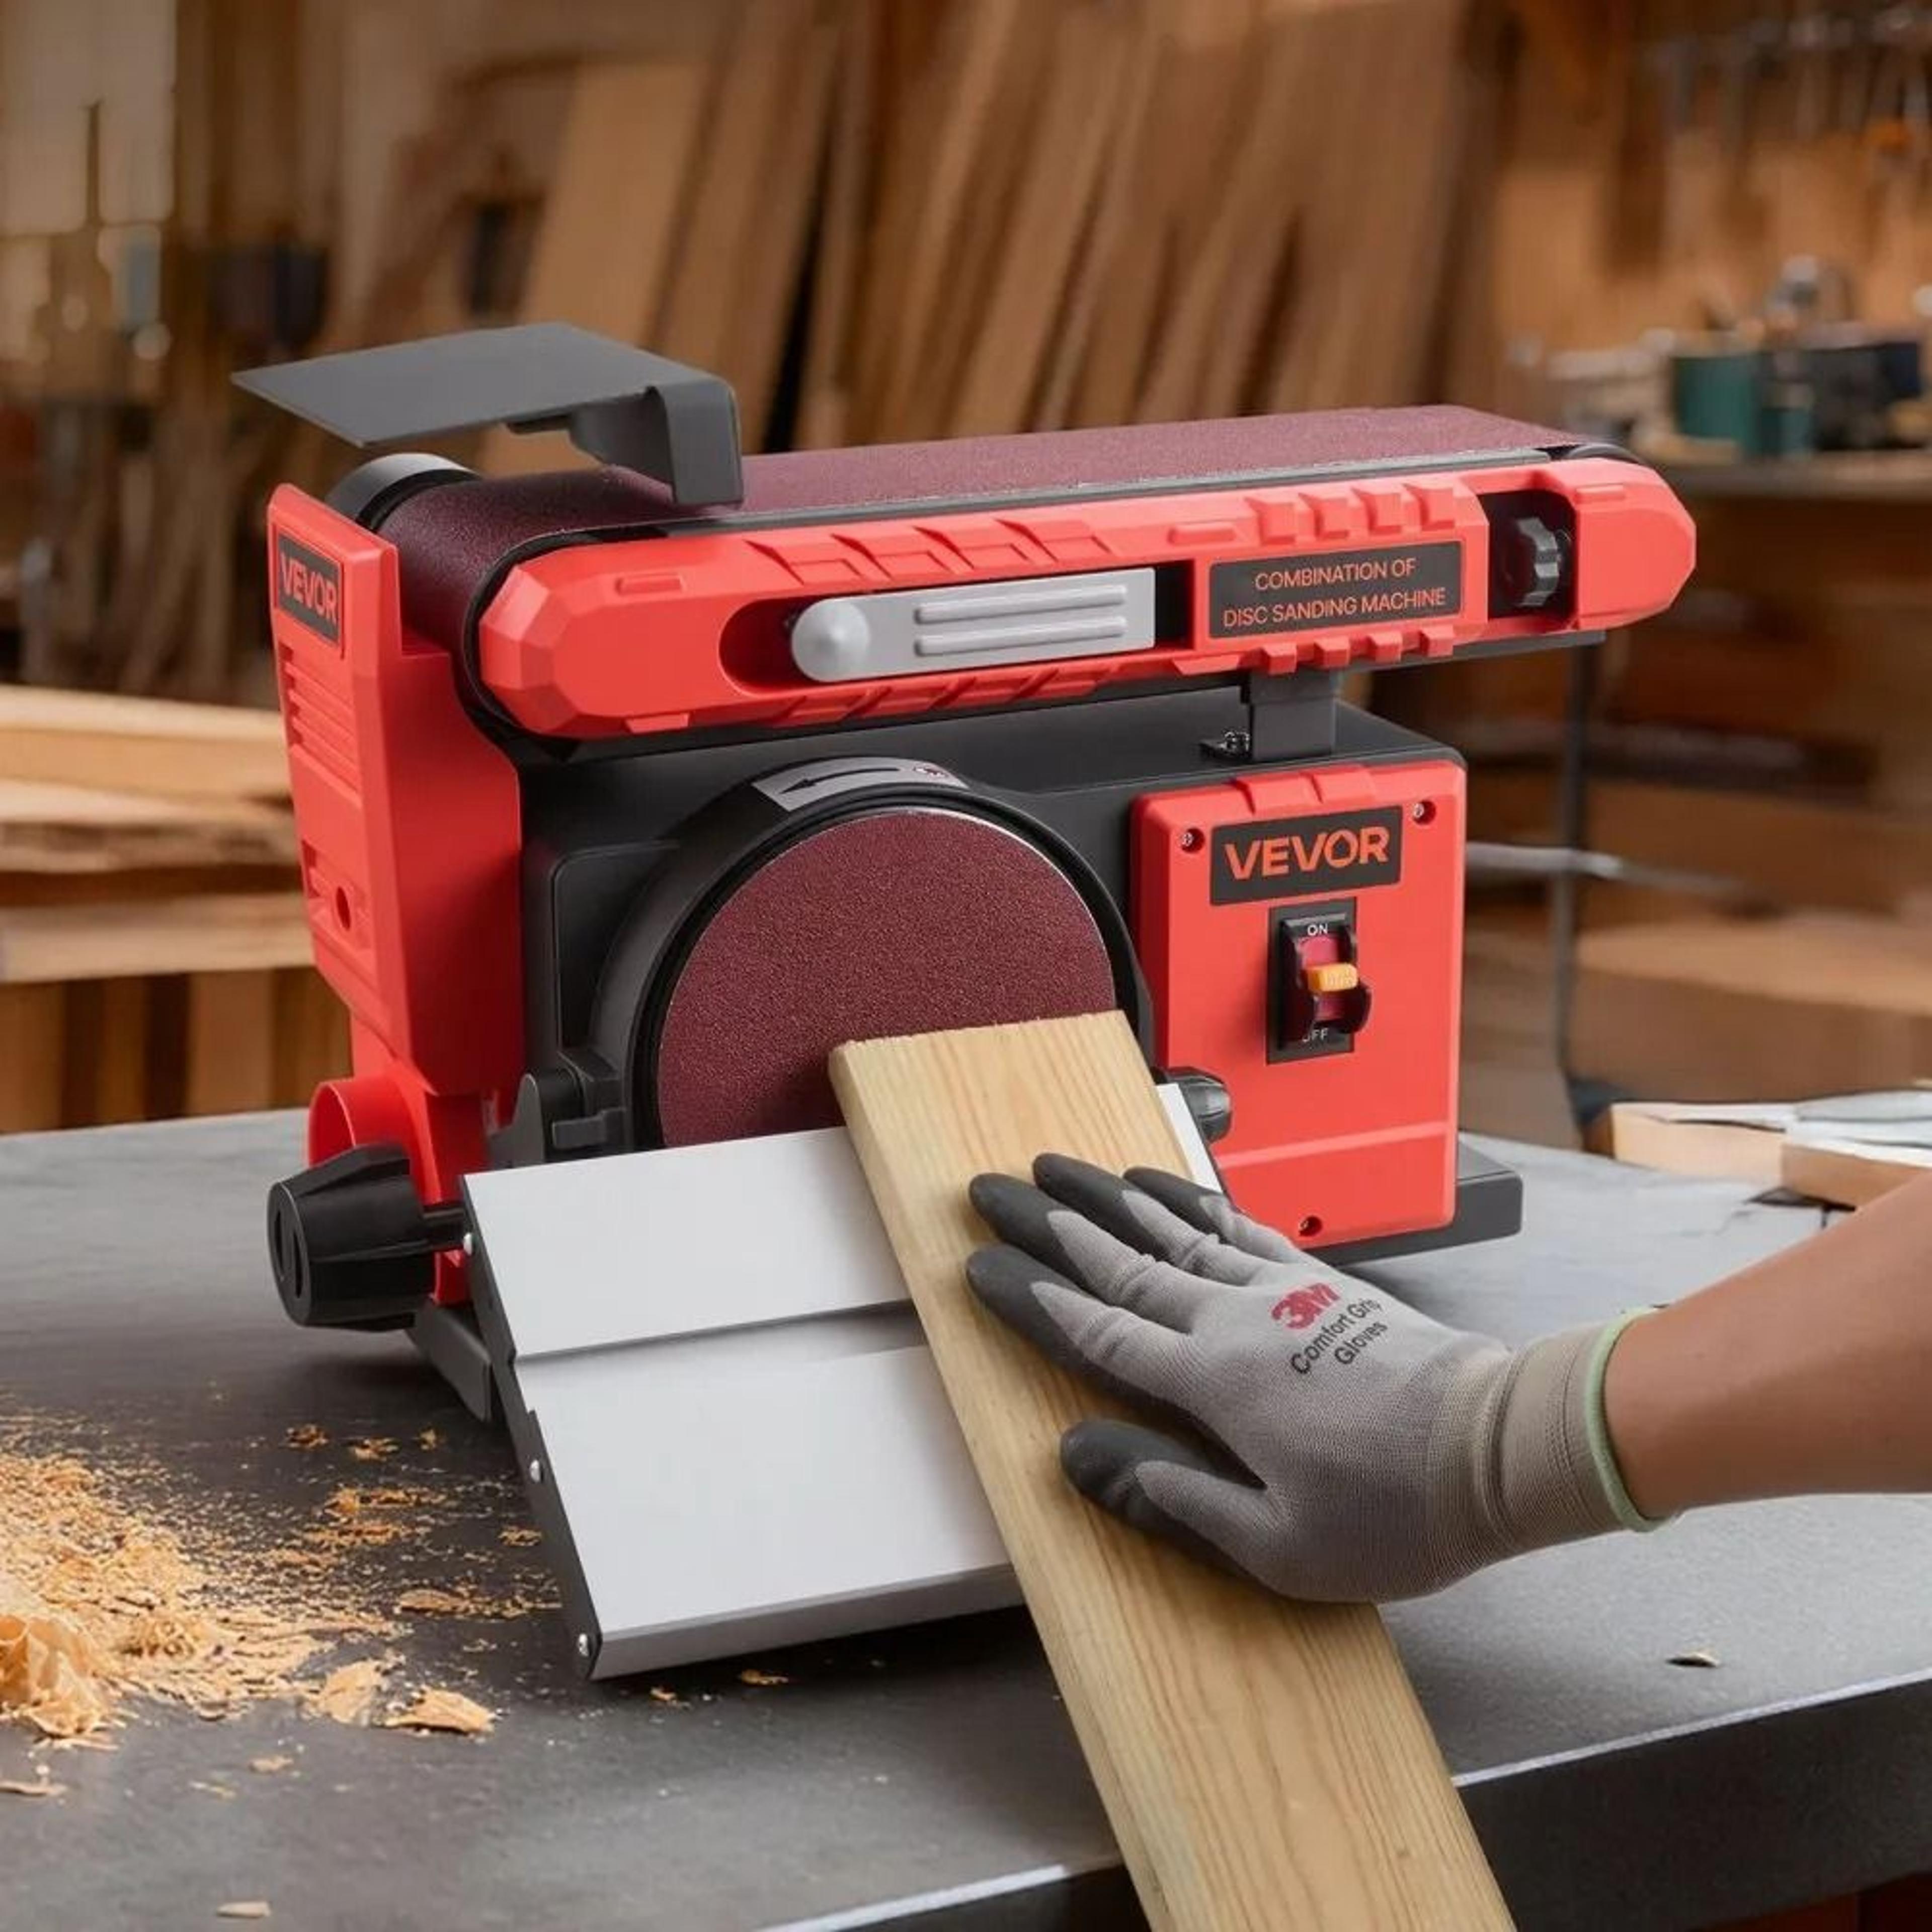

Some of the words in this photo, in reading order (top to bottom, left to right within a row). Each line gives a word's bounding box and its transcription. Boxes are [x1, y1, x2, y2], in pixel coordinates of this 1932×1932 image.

[280, 552, 337, 625] VEVOR
[1254, 562, 1388, 591] COMBINATION
[1391, 557, 1417, 578] OF
[1223, 606, 1267, 627] DISC
[1272, 597, 1357, 623] SANDING
[1361, 587, 1446, 612] MACHINE
[1224, 826, 1390, 880] VEVOR
[1307, 924, 1328, 936] ON
[1272, 1283, 1340, 1329] 3M
[1291, 1314, 1356, 1375] Comfort
[1334, 1321, 1388, 1364] Gloves
